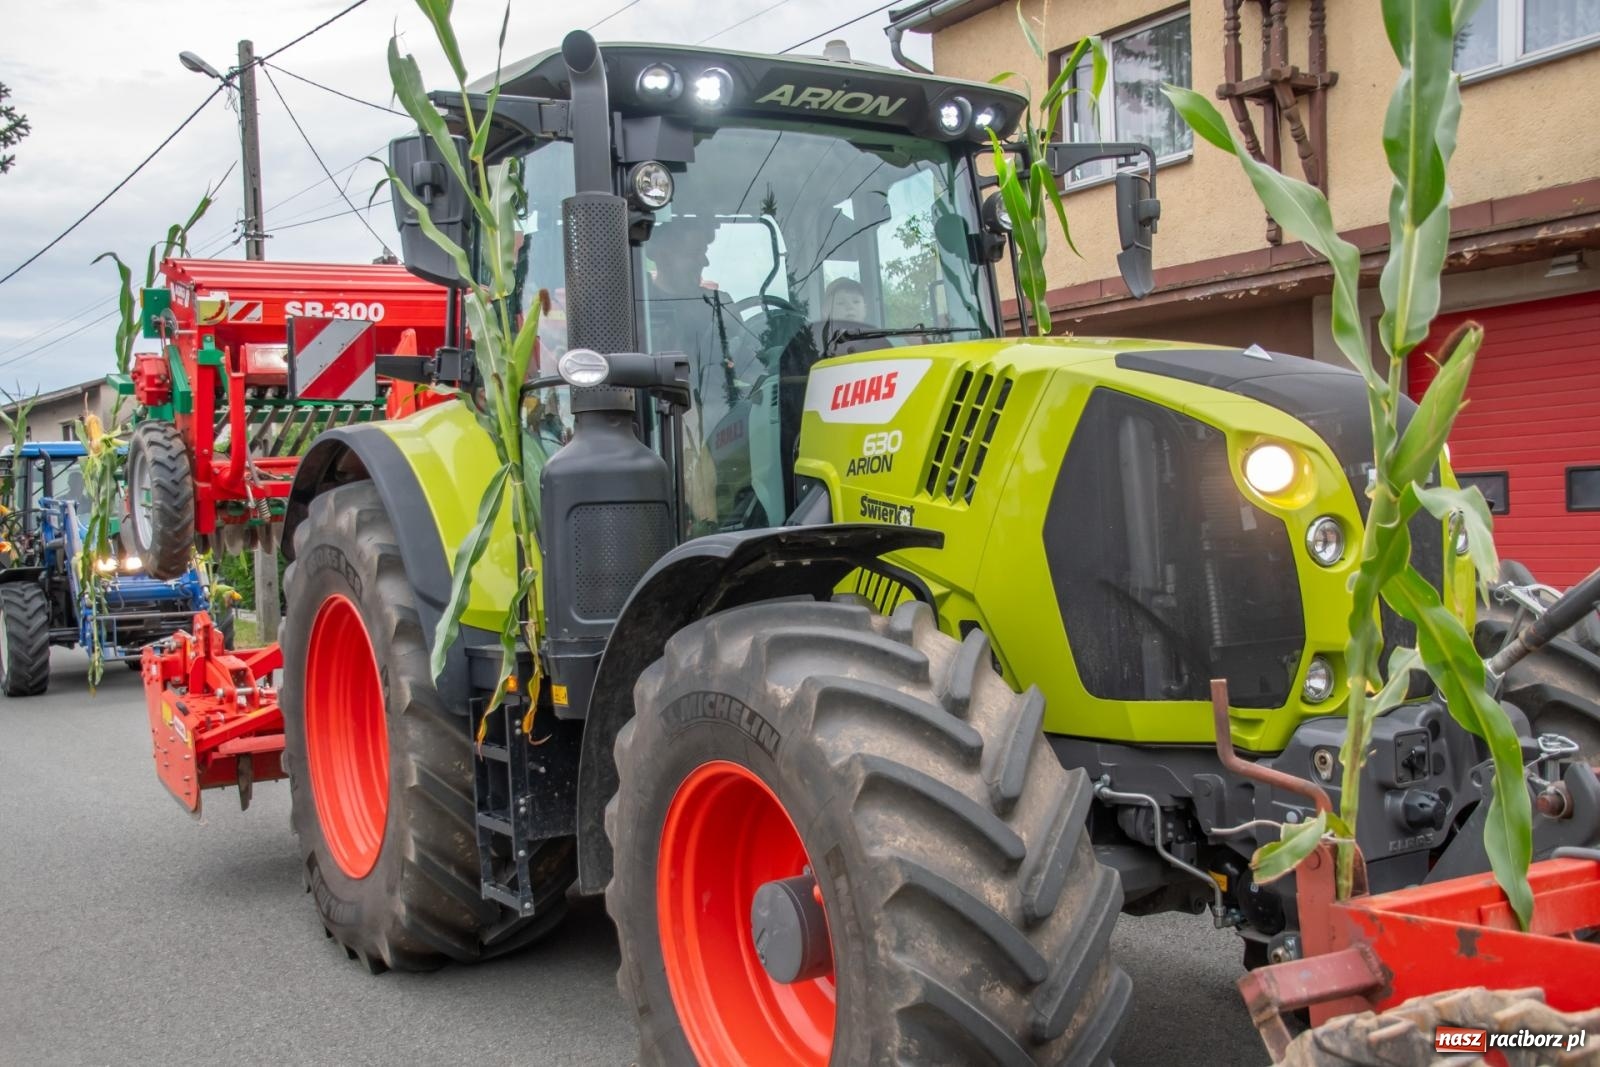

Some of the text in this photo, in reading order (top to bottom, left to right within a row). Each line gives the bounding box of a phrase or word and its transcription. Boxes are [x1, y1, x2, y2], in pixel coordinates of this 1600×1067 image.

[755, 84, 907, 117] ARION
[830, 371, 899, 411] CLAAS
[862, 430, 903, 457] 630
[846, 454, 894, 477] ARION
[679, 692, 780, 753] MICHELIN
